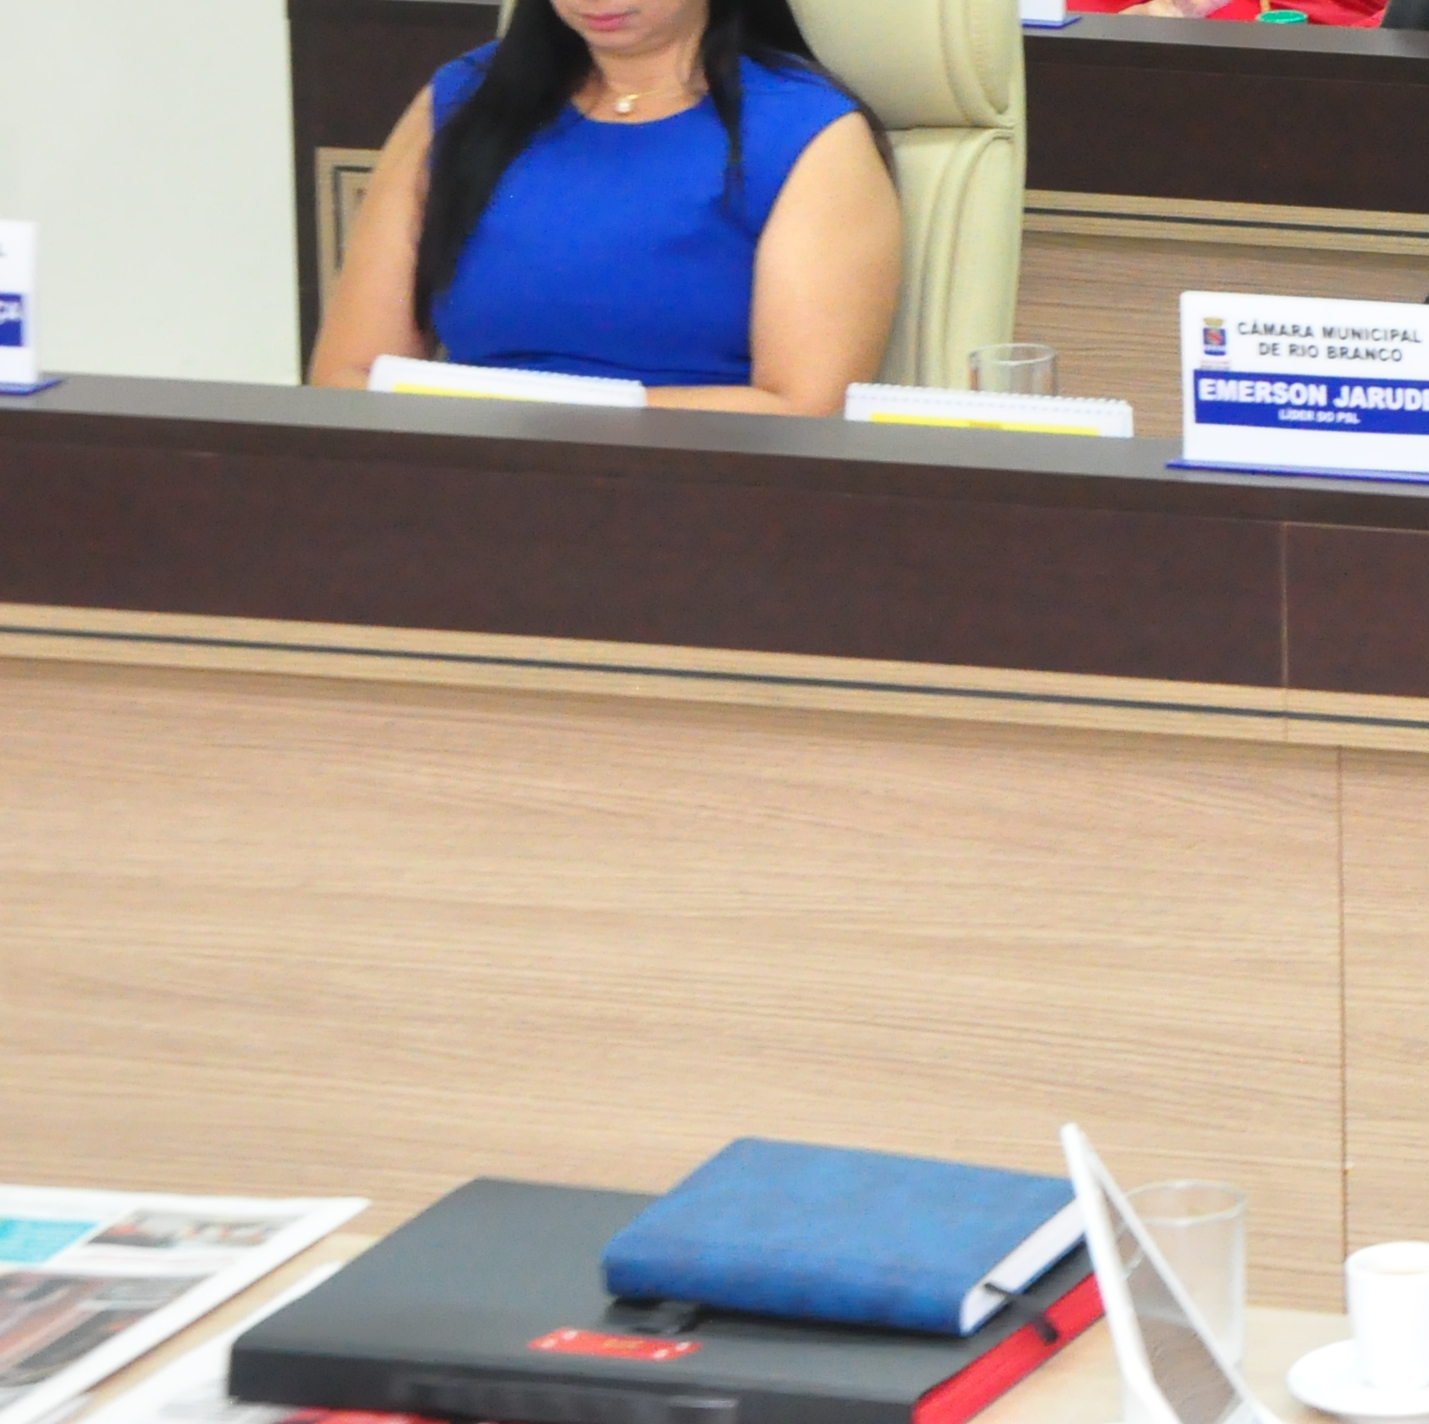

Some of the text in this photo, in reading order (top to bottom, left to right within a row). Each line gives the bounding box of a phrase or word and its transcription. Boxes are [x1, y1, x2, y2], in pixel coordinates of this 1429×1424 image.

[1237, 321, 1422, 344] CÂMARA MUNICIPAL
[1258, 341, 1403, 362] DE RIO BRANCO
[1197, 377, 1328, 407] EMERSON
[1316, 410, 1335, 423] DO
